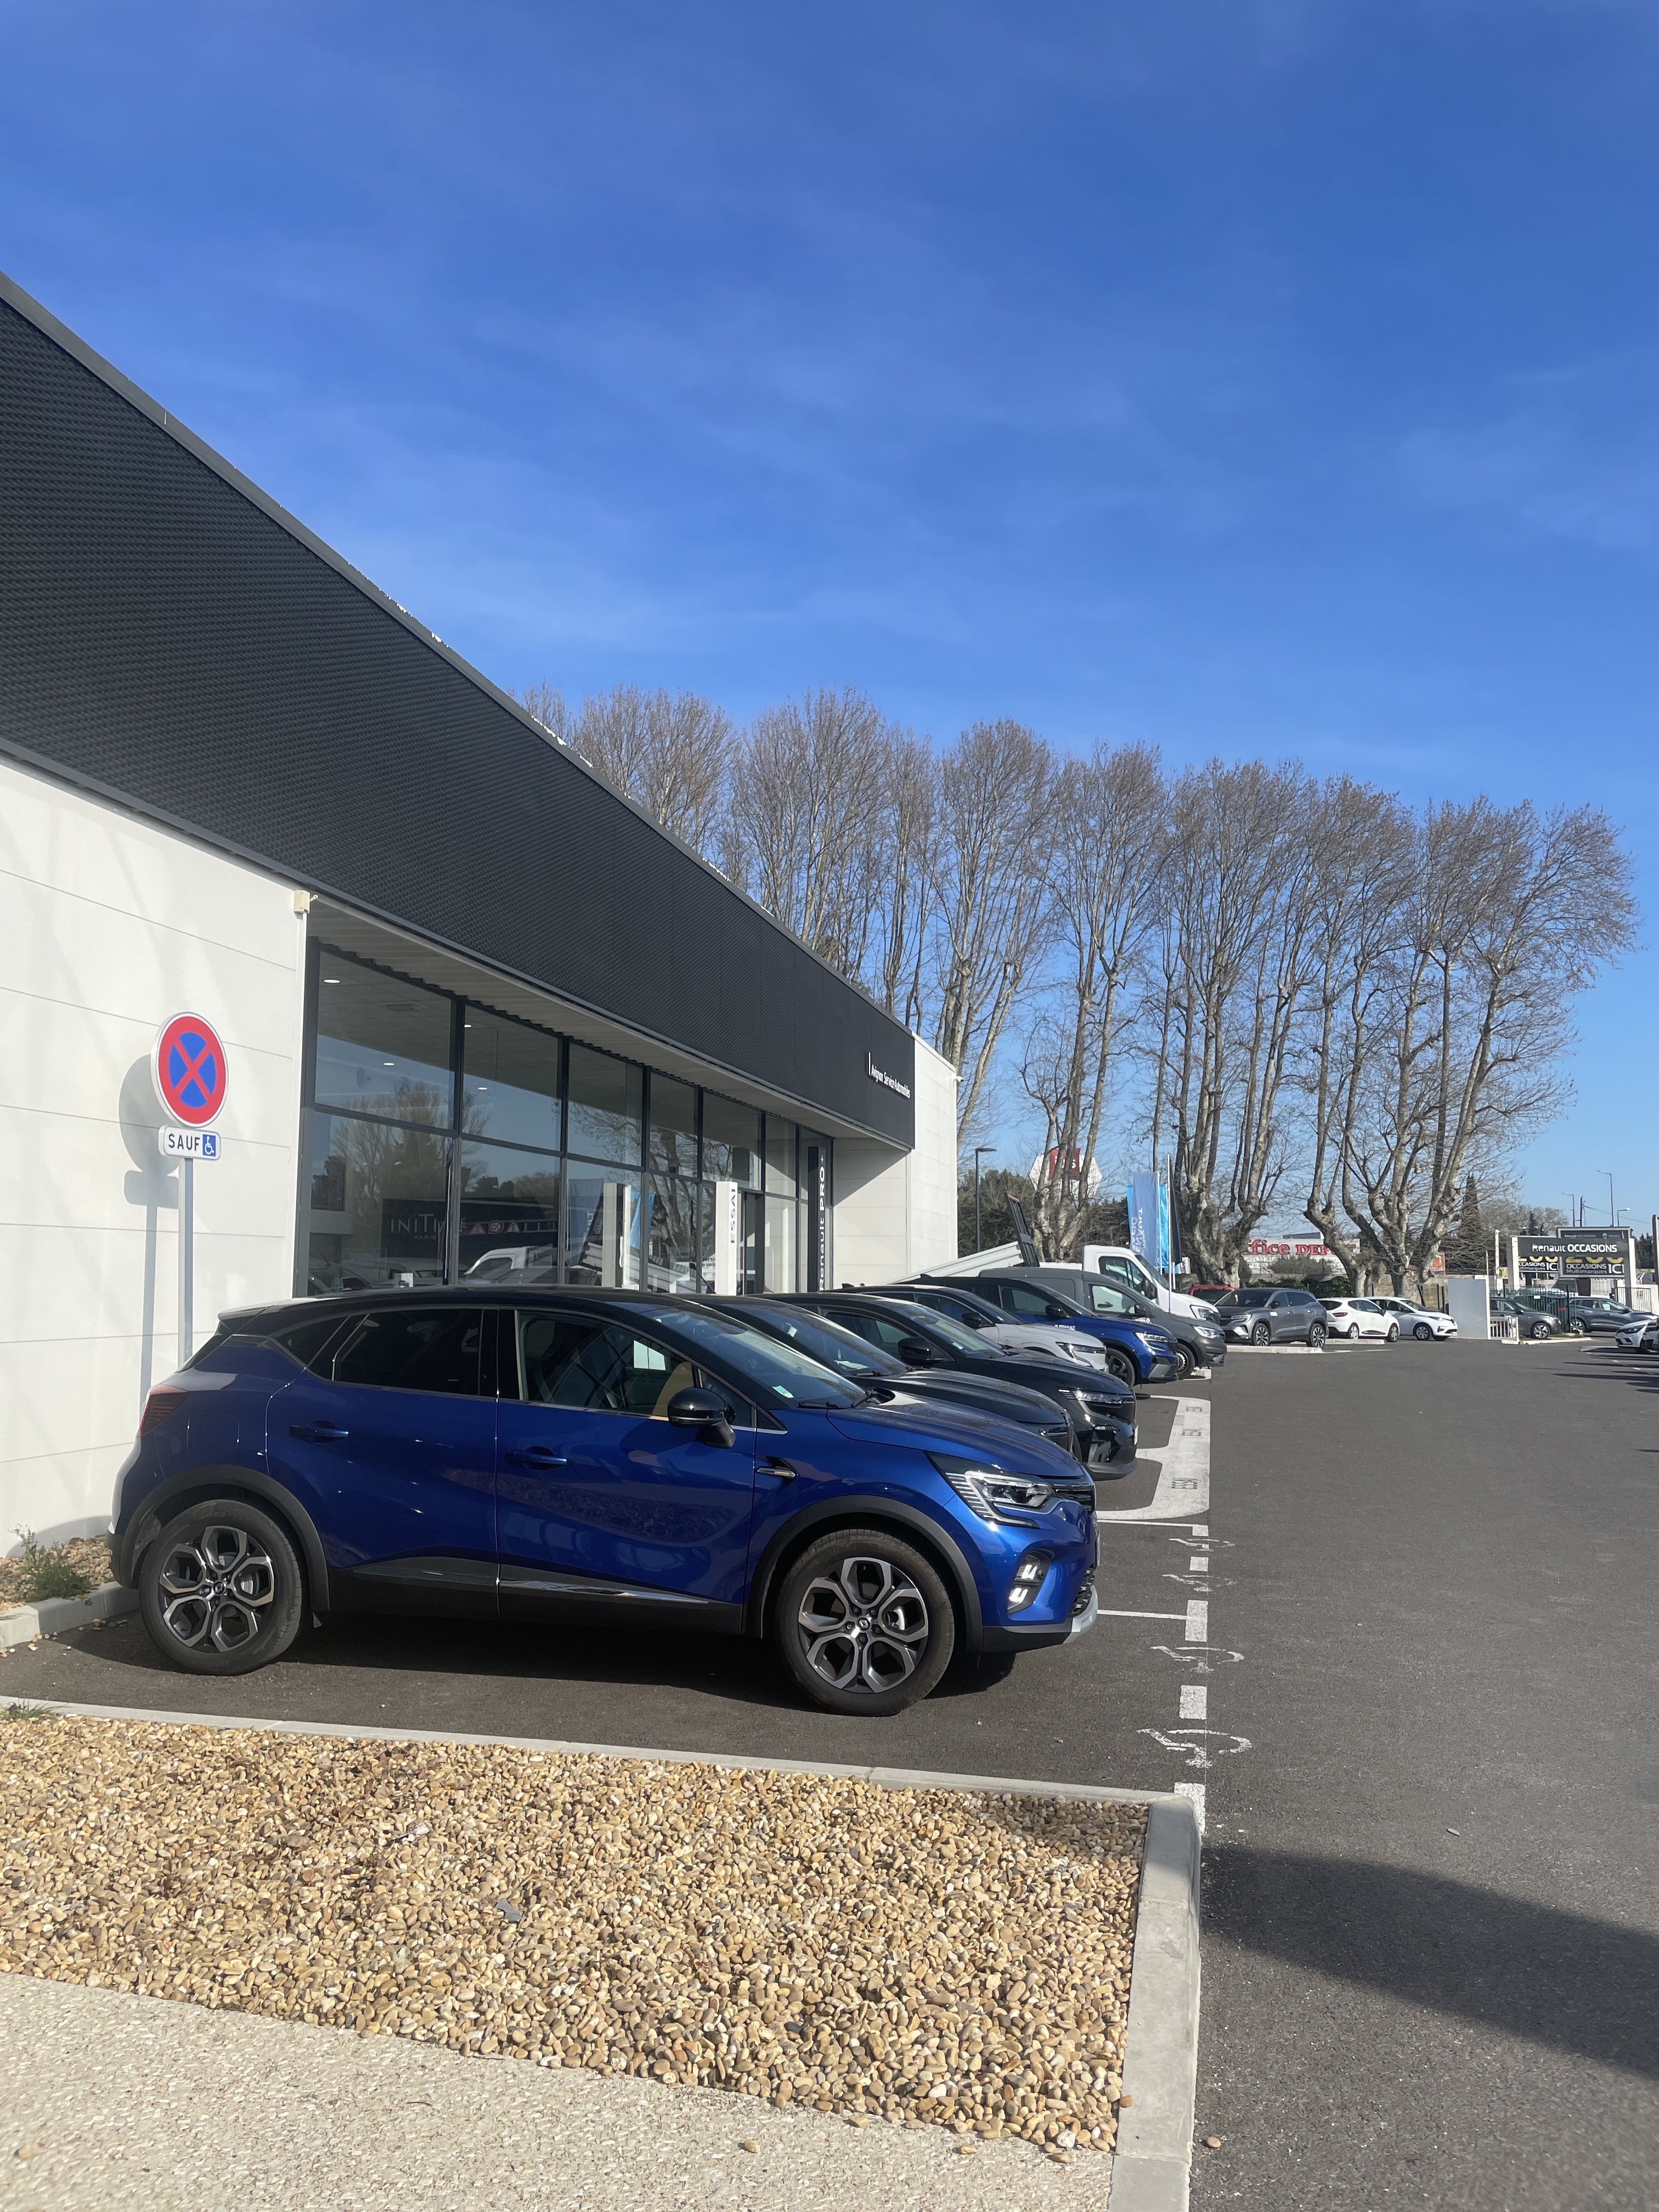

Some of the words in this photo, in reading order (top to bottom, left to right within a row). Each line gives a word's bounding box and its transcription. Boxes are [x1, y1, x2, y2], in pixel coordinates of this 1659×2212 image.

[168, 1133, 200, 1151] SAUF
[1532, 1244, 1566, 1252] Renault
[1567, 1244, 1618, 1252] OCCASIONS
